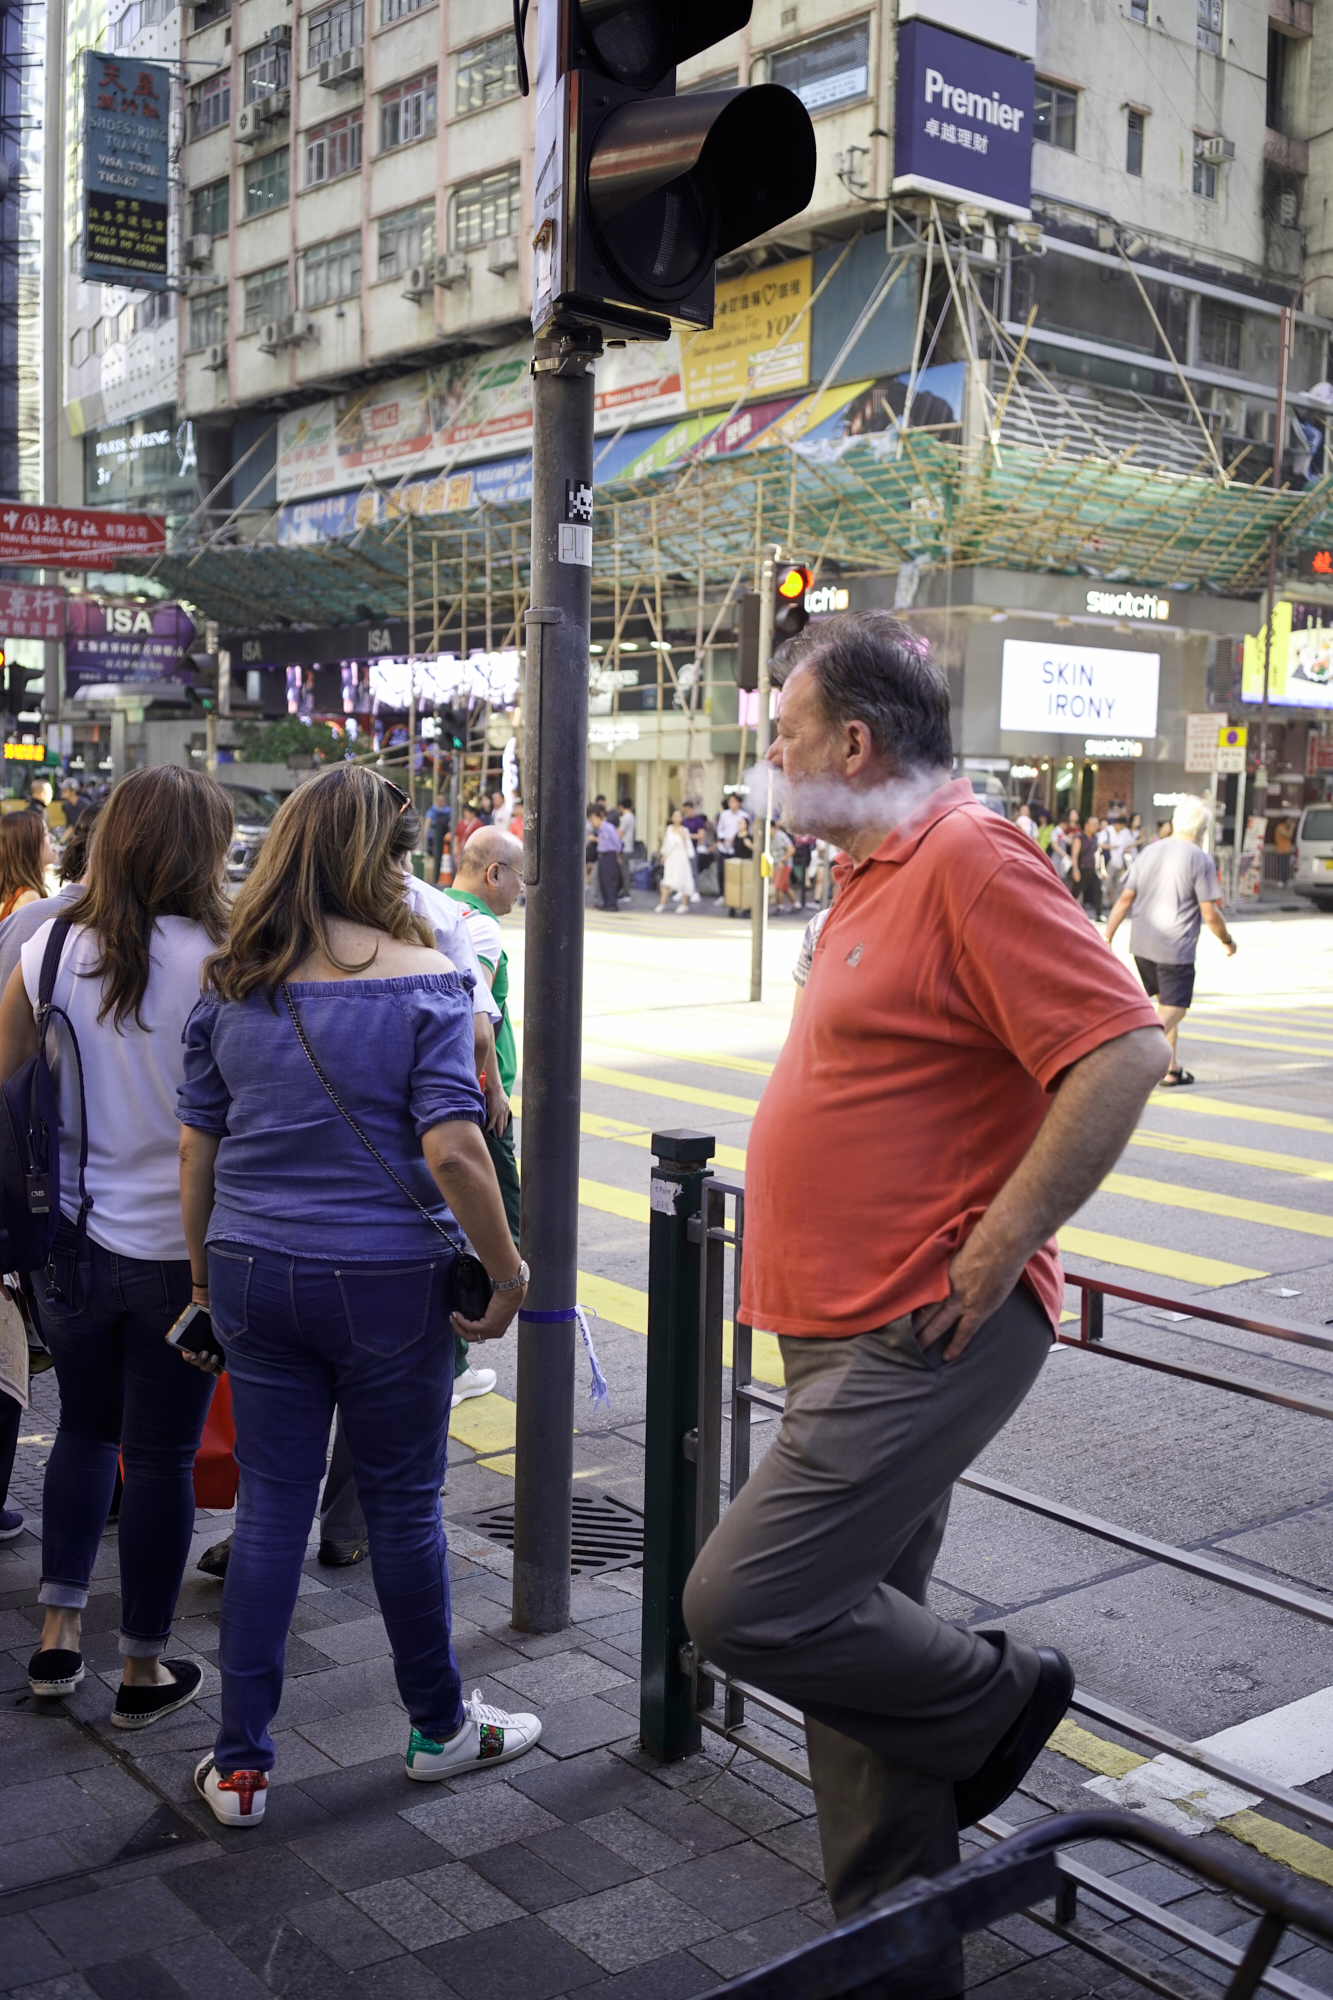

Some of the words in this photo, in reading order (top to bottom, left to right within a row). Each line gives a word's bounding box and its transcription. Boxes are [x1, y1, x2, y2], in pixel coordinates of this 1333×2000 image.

[99, 64, 159, 99] 天星
[925, 68, 1024, 133] Premier
[105, 135, 151, 158] TRAVEL
[924, 118, 989, 154] 卓越理財
[97, 154, 124, 170] VISA
[98, 171, 139, 188] TICKET
[88, 222, 117, 236] WORLD
[96, 438, 127, 457] PARIS
[129, 430, 170, 450] SPRING
[0, 532, 30, 546] TRAVEL
[31, 534, 65, 549] SERVICE
[105, 523, 149, 541] 有限公司
[1086, 590, 1157, 619] swatch
[106, 607, 153, 634] ISA
[243, 640, 262, 662] ISA
[368, 628, 392, 653] ISA
[1043, 661, 1094, 687] SKIN
[1048, 694, 1116, 719] IRONY
